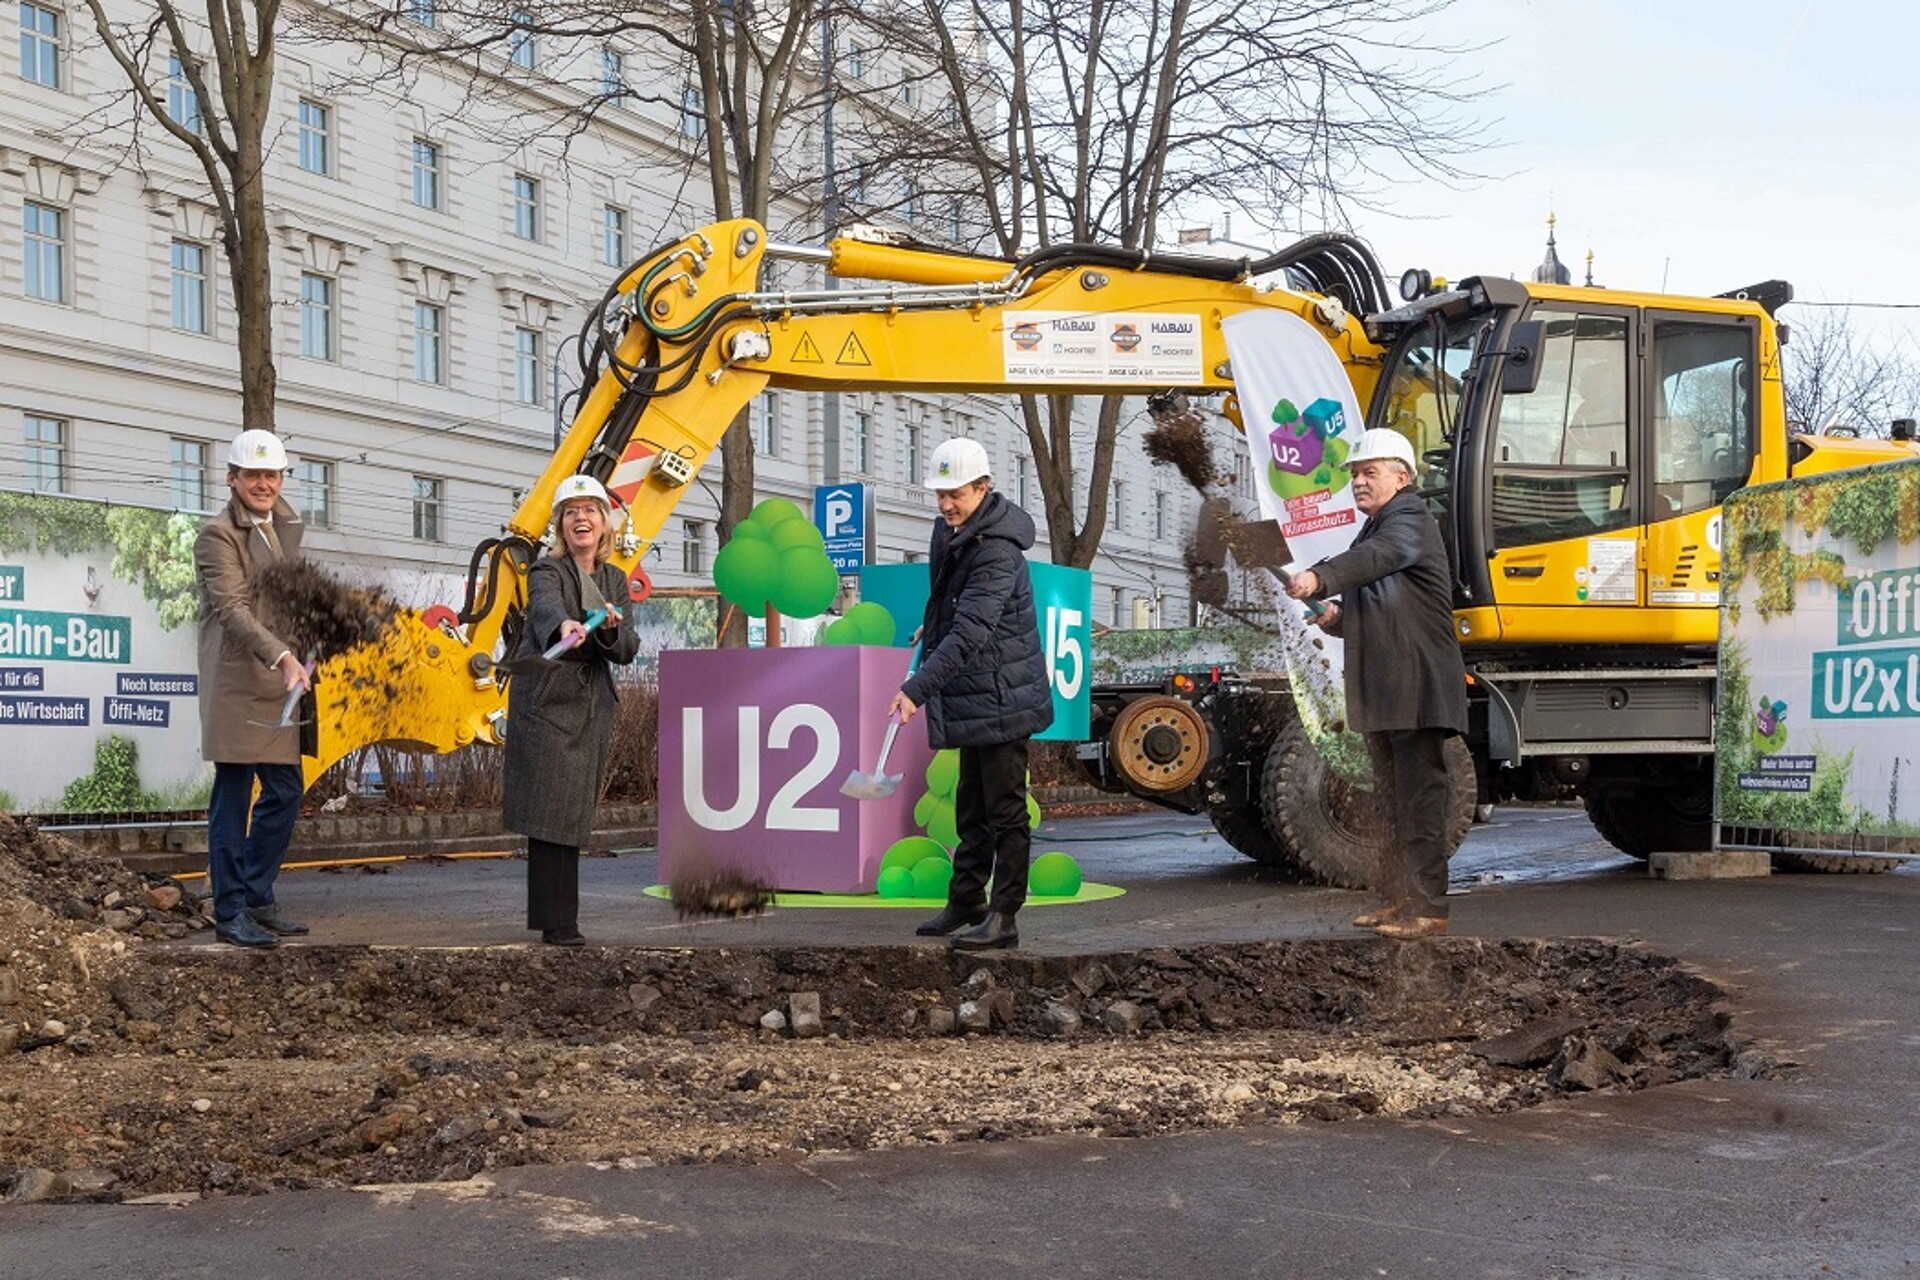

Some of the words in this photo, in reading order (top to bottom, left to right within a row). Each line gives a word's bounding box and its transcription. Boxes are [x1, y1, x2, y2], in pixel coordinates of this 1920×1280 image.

[1052, 319, 1096, 331] HABAU
[1151, 322, 1193, 333] HABAU
[1325, 411, 1344, 434] U5
[1272, 442, 1302, 467] U2
[826, 500, 852, 537] P
[847, 558, 858, 567] m
[1852, 568, 1920, 638] Öffi
[0, 613, 120, 660] ahn-Bau
[4, 671, 20, 687] für
[23, 672, 40, 687] die
[121, 677, 147, 692] Noch
[149, 678, 195, 692] besseres
[16, 701, 85, 720] Wirtschaft
[109, 698, 165, 722] Öffi-Netz
[682, 703, 840, 832] U2
